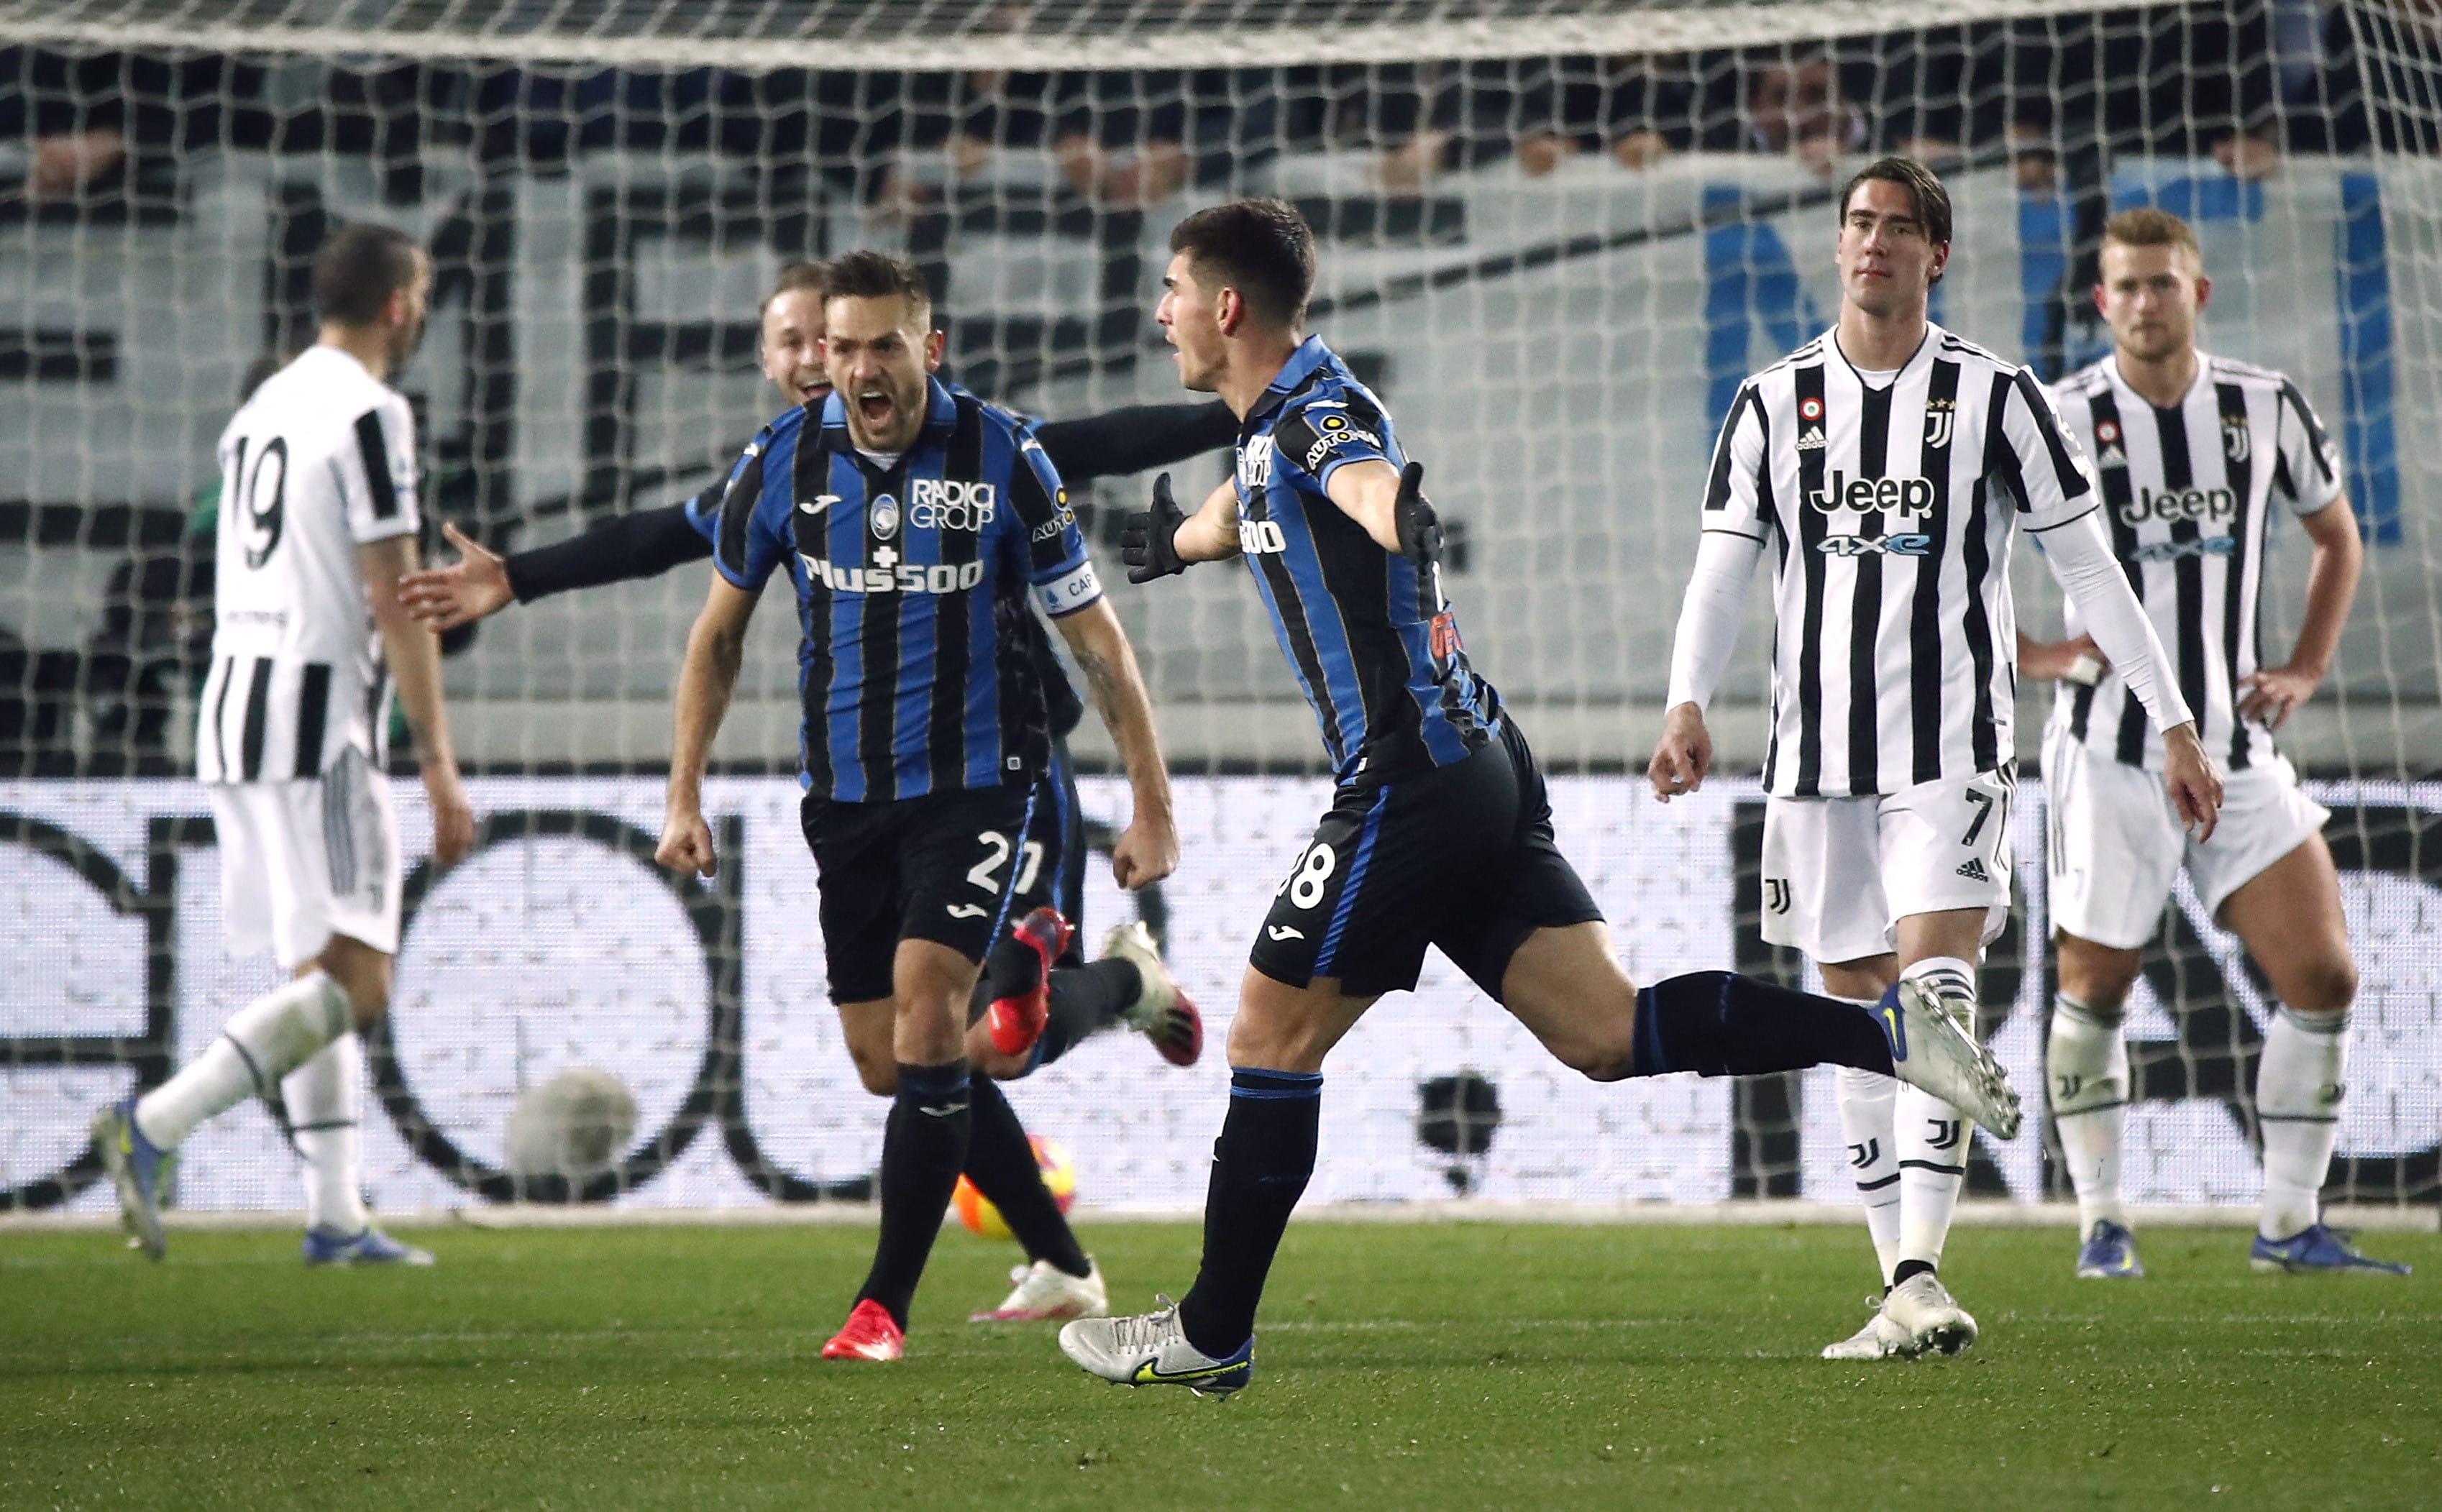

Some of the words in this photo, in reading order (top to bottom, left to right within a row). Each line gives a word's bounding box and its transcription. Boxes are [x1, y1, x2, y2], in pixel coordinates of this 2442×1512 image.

[232, 435, 289, 571] 19
[910, 504, 994, 531] GROUP
[912, 479, 995, 509] RADICI
[1809, 469, 1934, 519] Jeep
[2121, 483, 2238, 528] Jeep
[797, 551, 984, 594] Plus500
[1961, 787, 1993, 846] 7
[1277, 837, 1335, 910] 8
